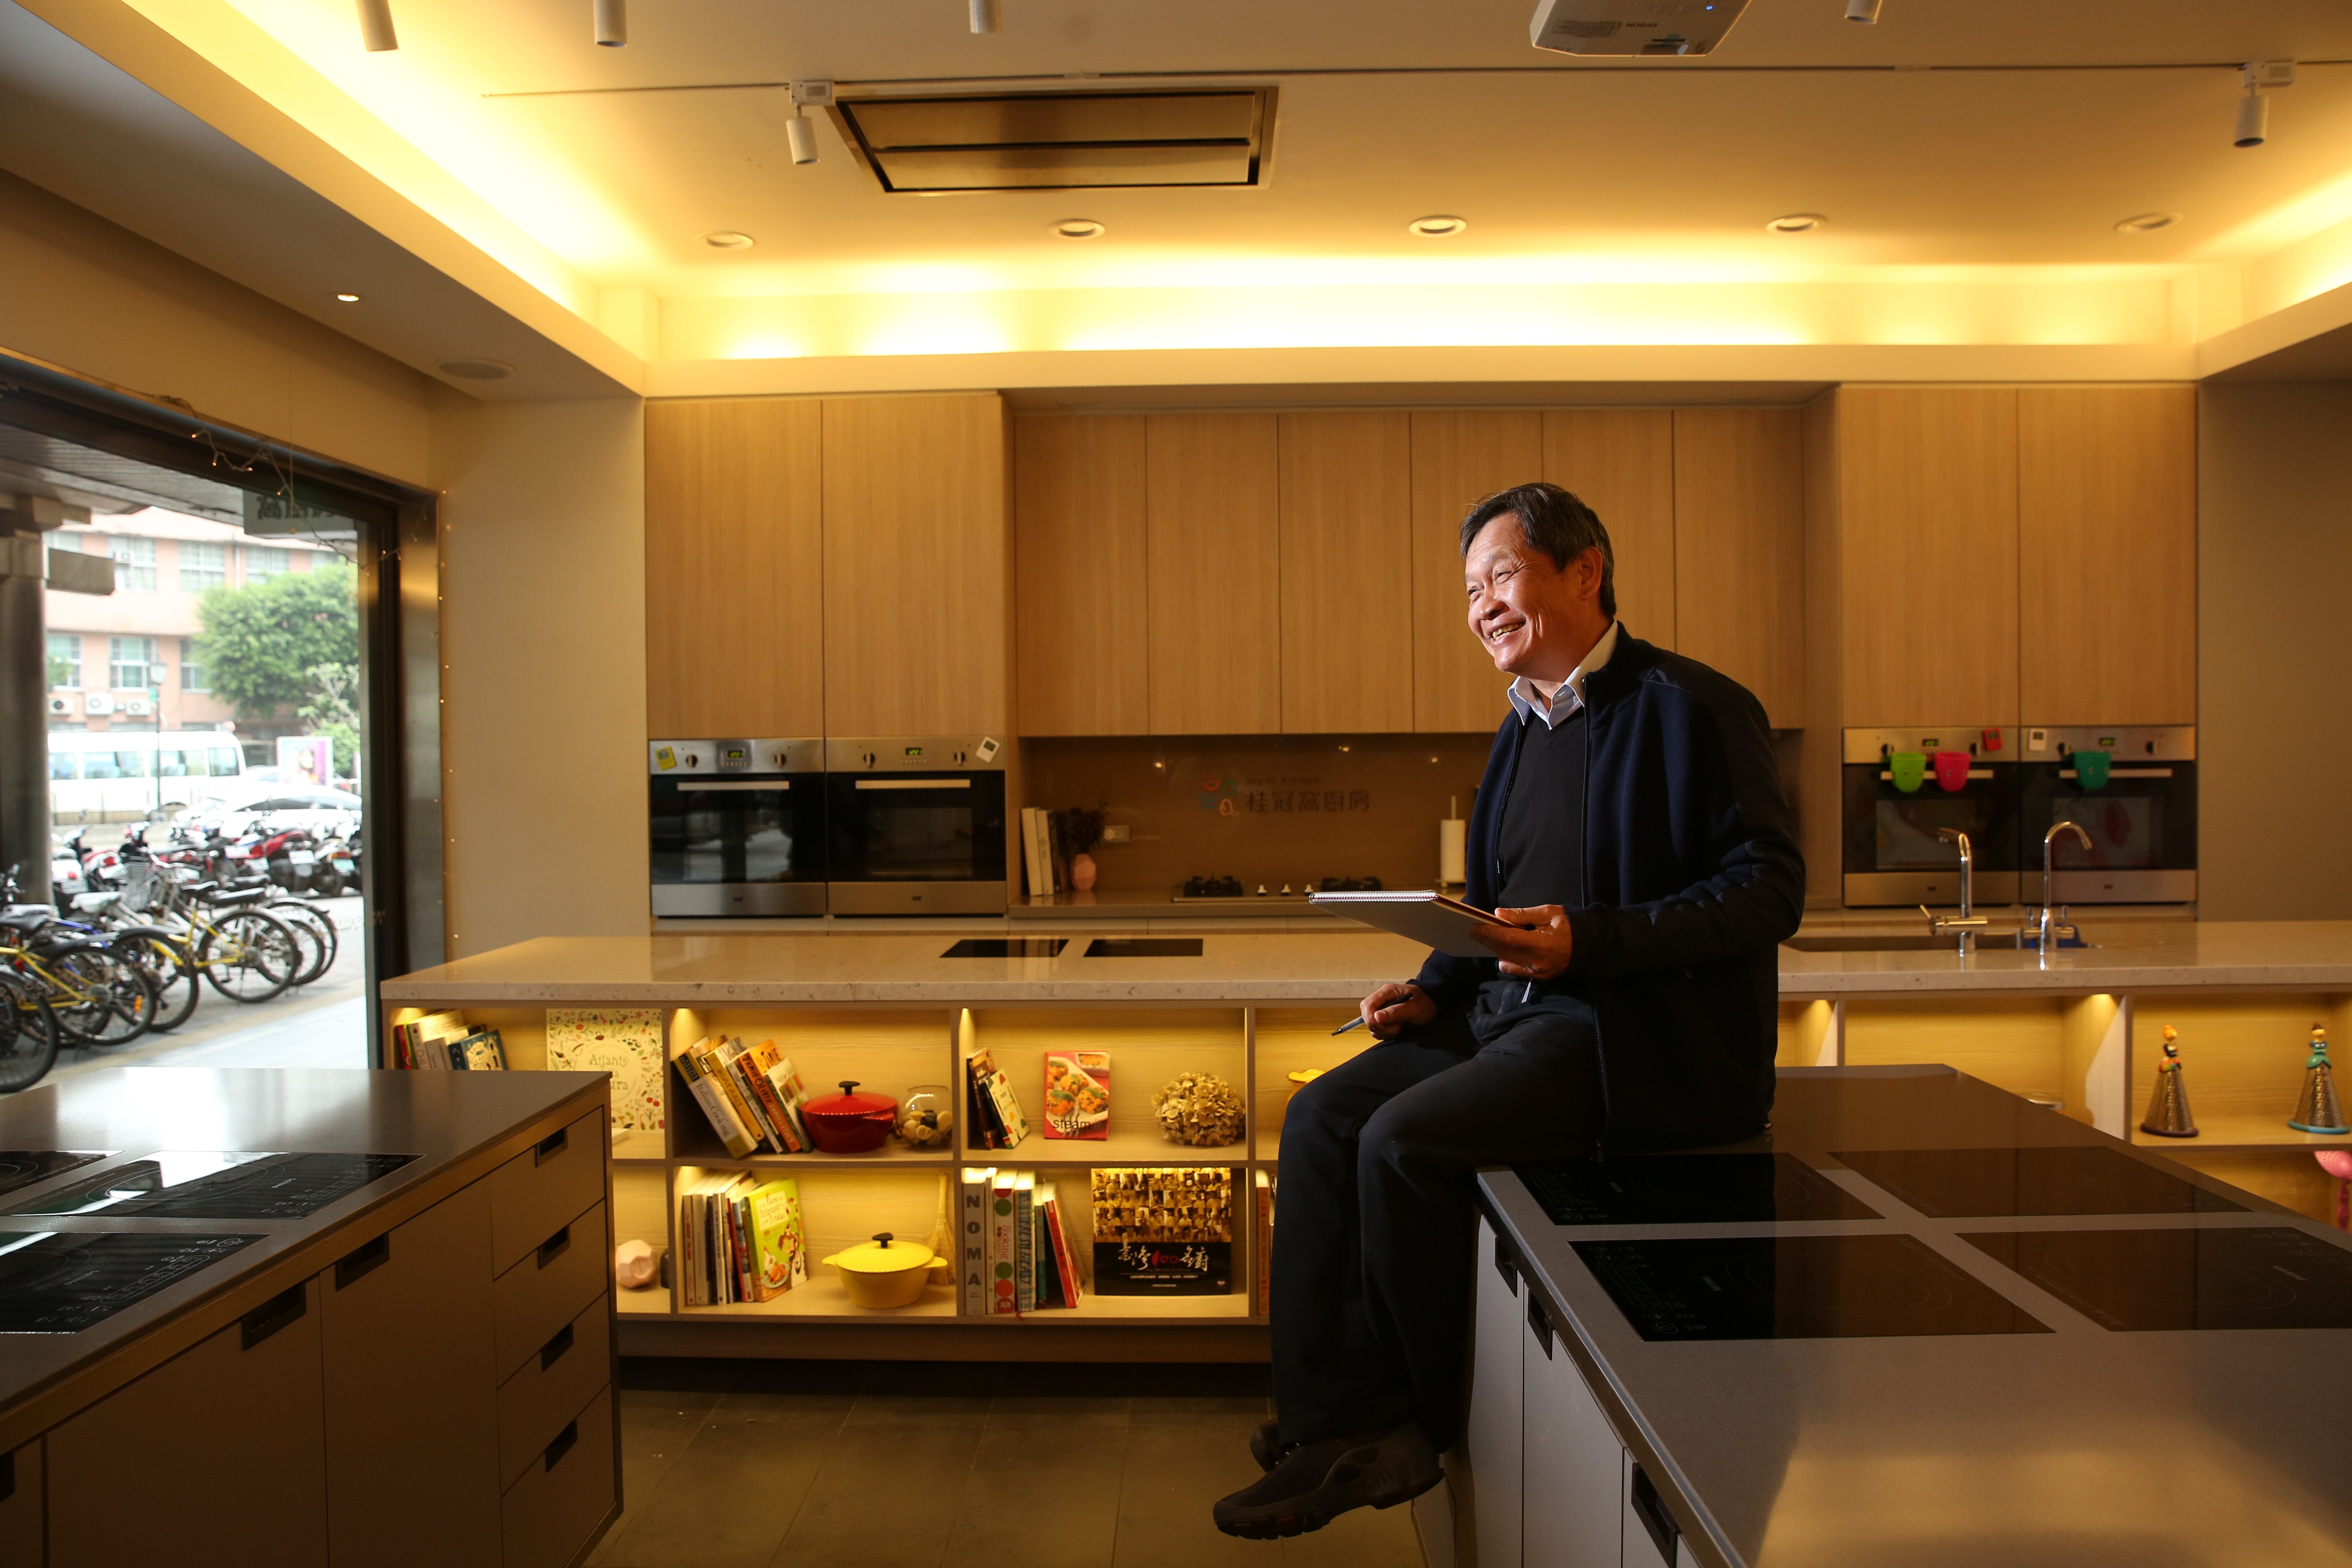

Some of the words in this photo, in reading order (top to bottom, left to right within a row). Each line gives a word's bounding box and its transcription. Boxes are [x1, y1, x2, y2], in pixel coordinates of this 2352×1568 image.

[1247, 790, 1370, 813] 桂冠窩廚房
[589, 1054, 628, 1067] Atlante
[696, 1083, 711, 1107] Italian
[710, 1105, 730, 1137] Cooking
[1053, 1118, 1091, 1130] steam
[966, 1195, 981, 1285] NOMA
[1001, 1225, 1010, 1260] cooking
[1019, 1221, 1032, 1250] FRESH
[1020, 1260, 1033, 1286] EASY
[1700, 1276, 1723, 1292] PHILIPS
